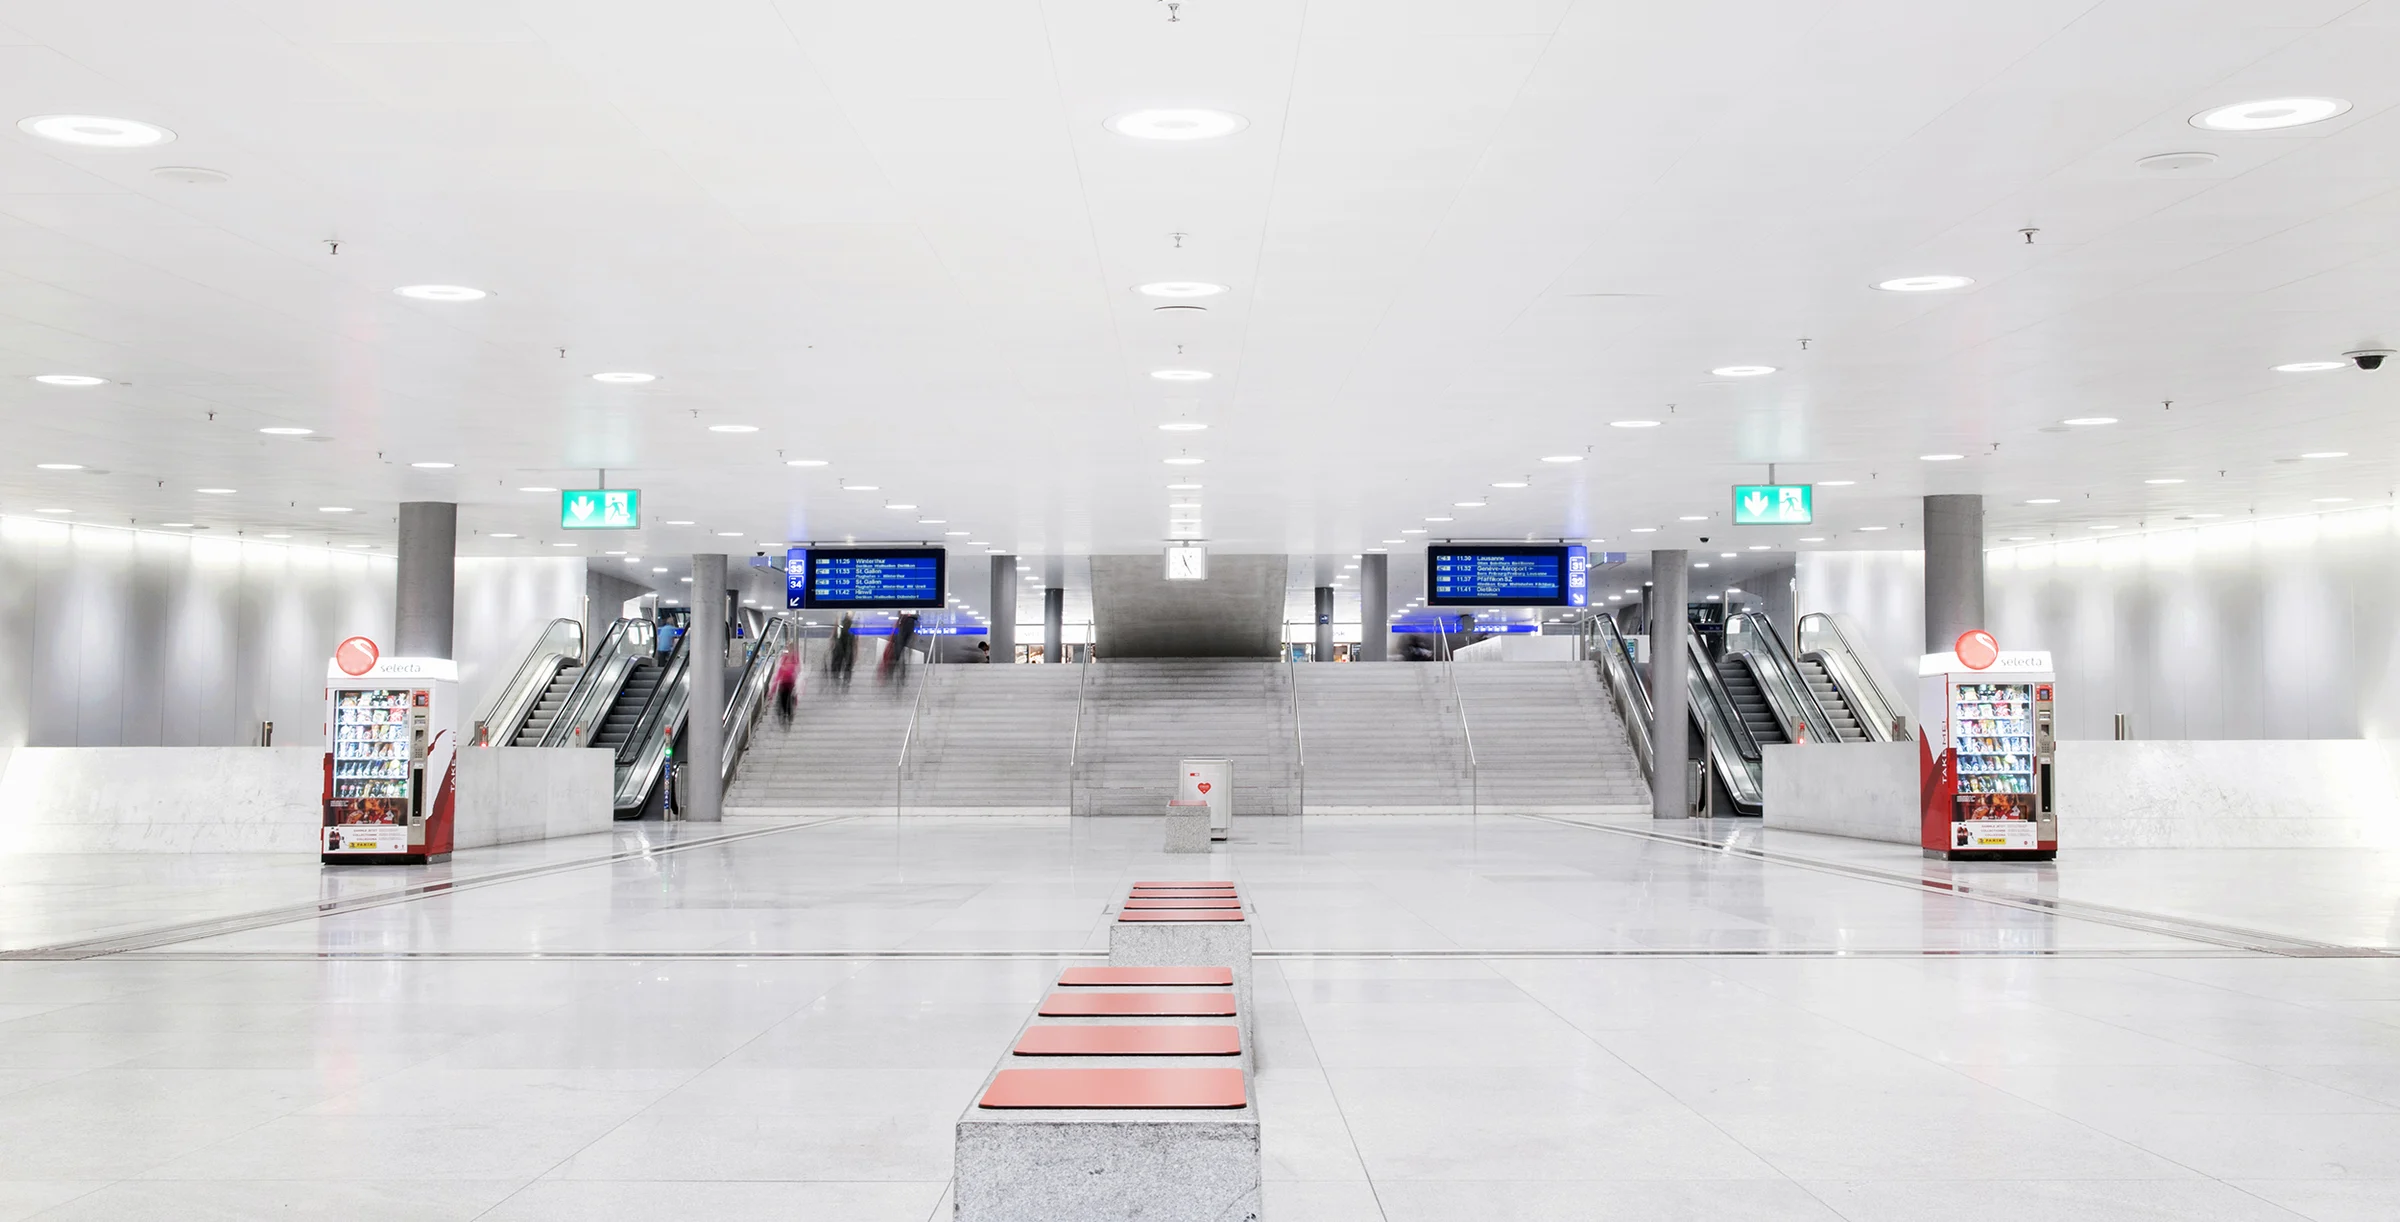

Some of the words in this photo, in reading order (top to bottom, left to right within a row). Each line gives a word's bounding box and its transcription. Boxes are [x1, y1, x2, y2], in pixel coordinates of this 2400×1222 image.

[790, 565, 802, 573] 33
[1572, 562, 1583, 570] 31
[790, 580, 802, 588] 34
[1571, 577, 1583, 585] 32
[2000, 657, 2042, 666] selecta
[380, 663, 421, 673] selecta
